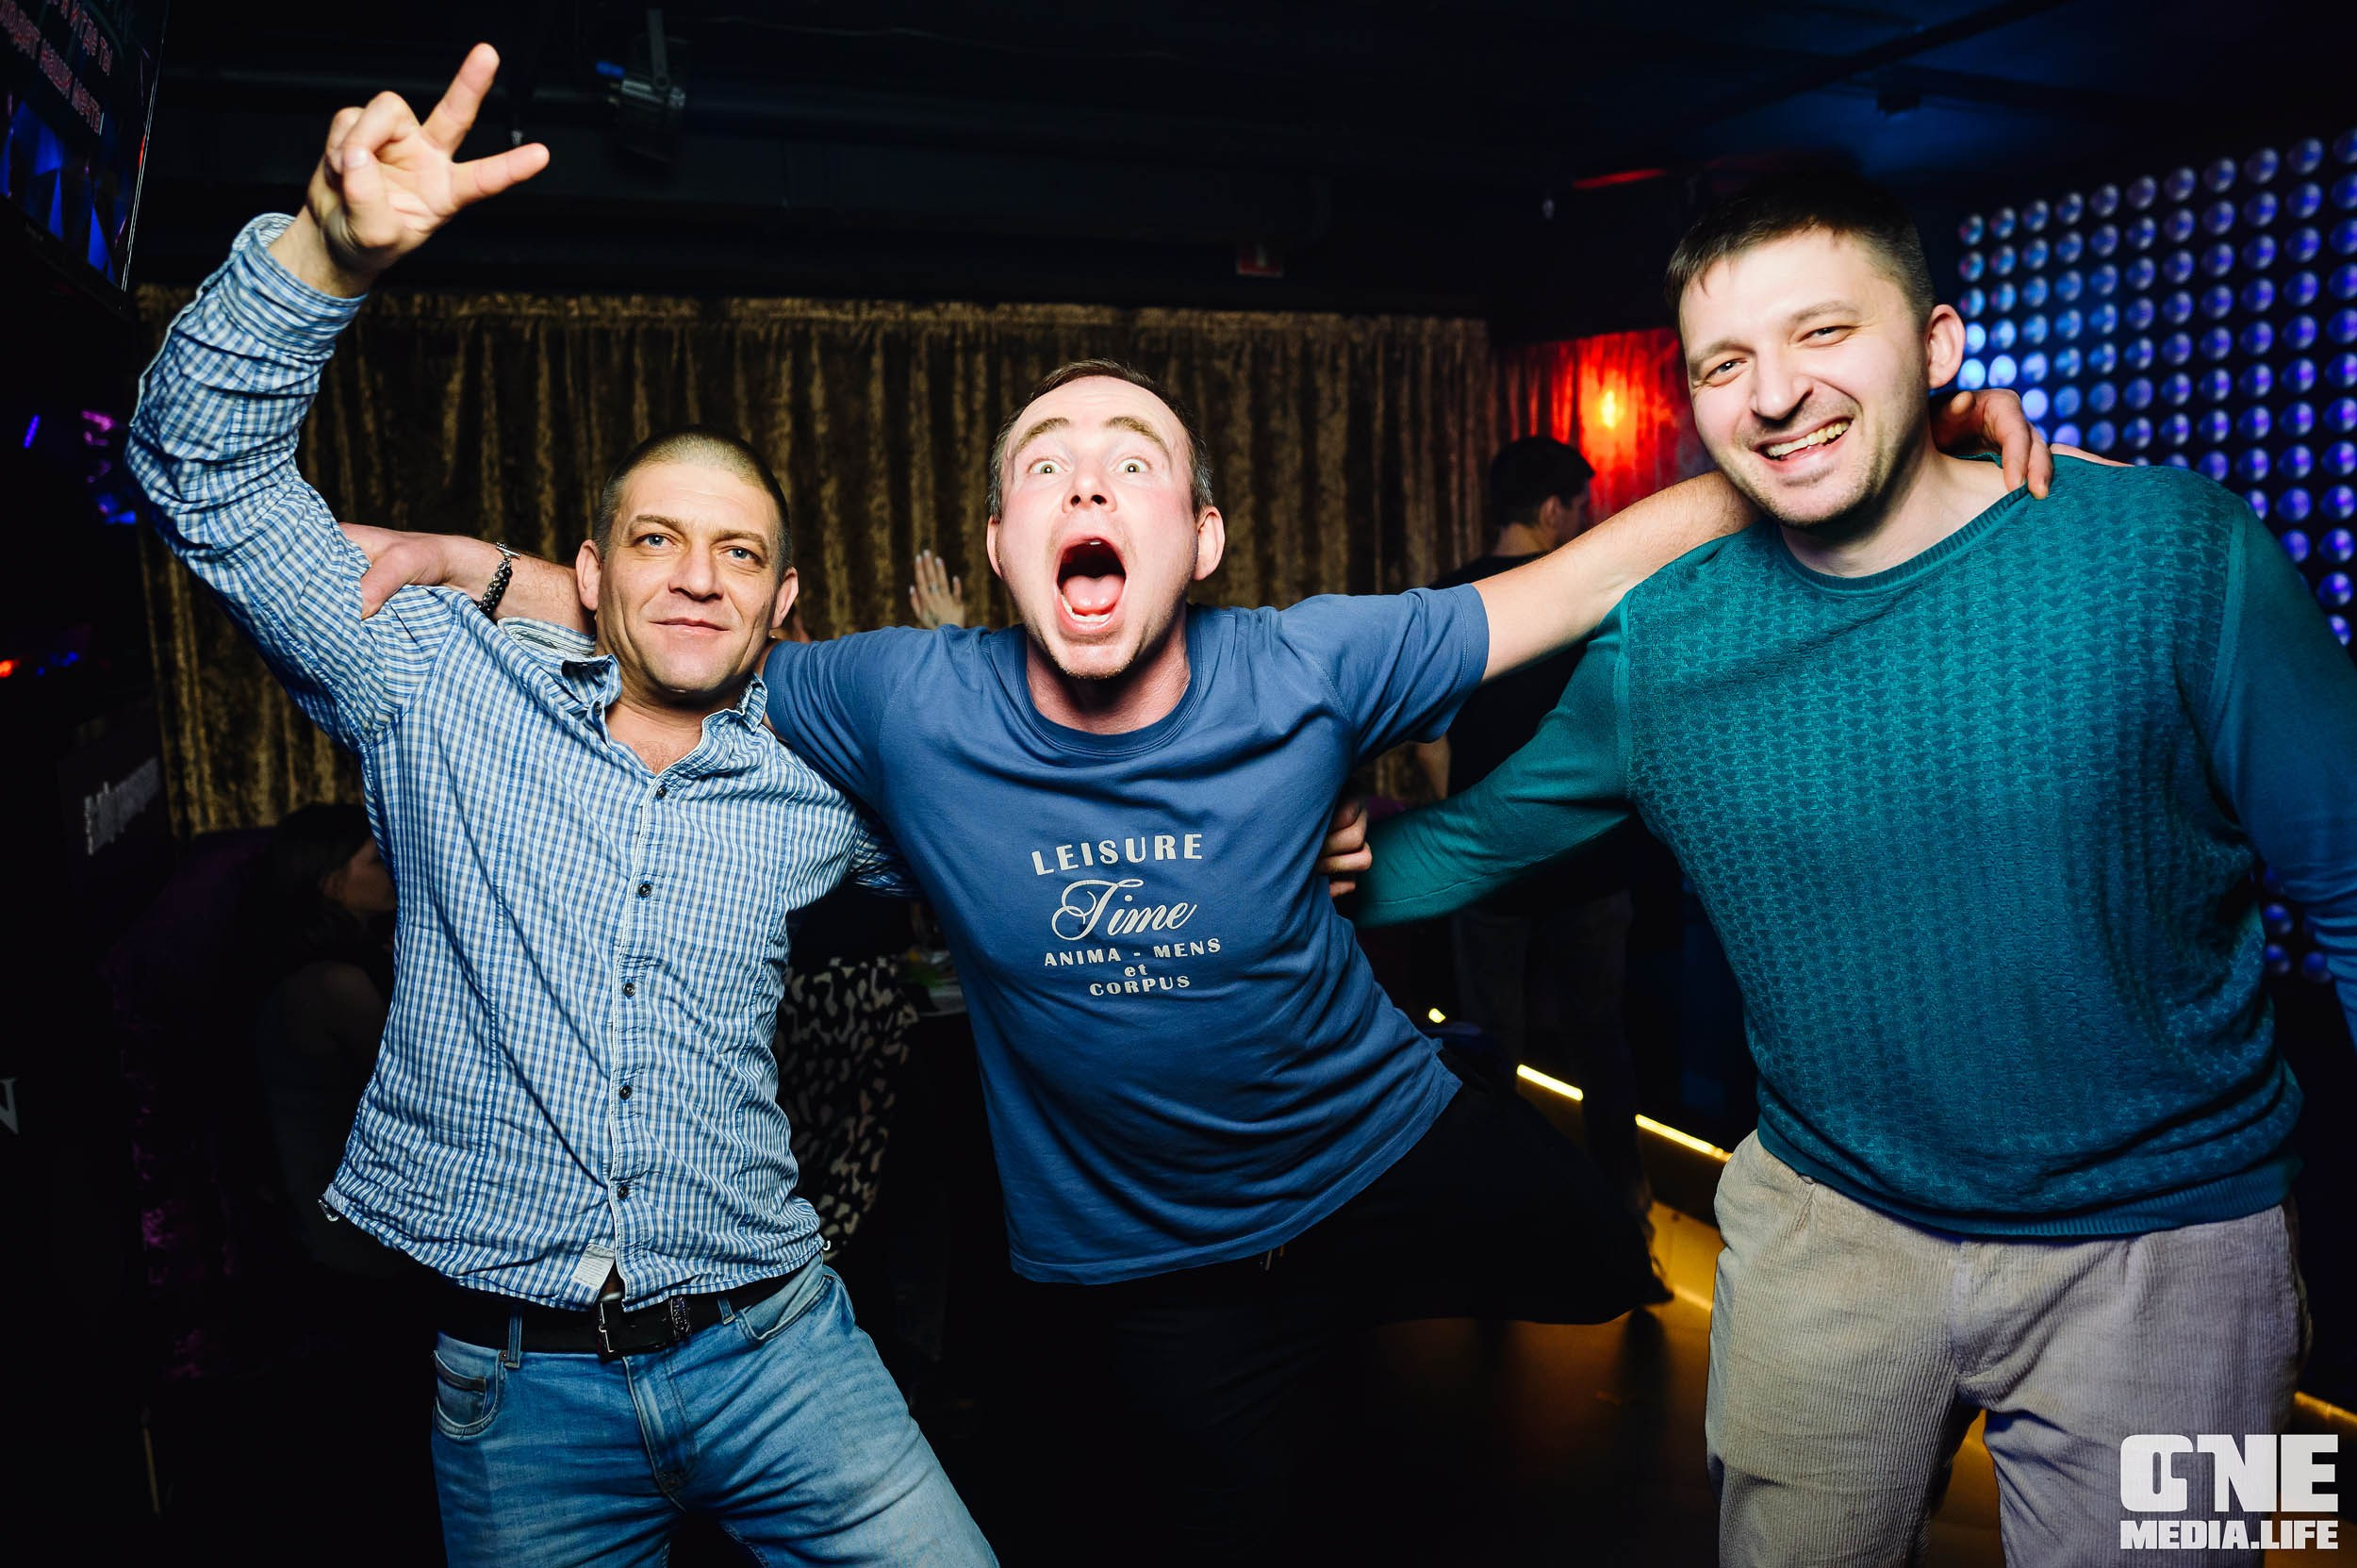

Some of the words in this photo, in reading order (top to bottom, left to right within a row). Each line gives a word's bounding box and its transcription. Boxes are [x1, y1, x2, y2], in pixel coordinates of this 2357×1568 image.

[1031, 834, 1202, 875] LEISURE
[1051, 878, 1197, 941] Time
[1044, 948, 1121, 966] ANIMA
[1153, 938, 1221, 958] MENS
[1124, 964, 1147, 977] et
[1089, 975, 1190, 996] CORPUS
